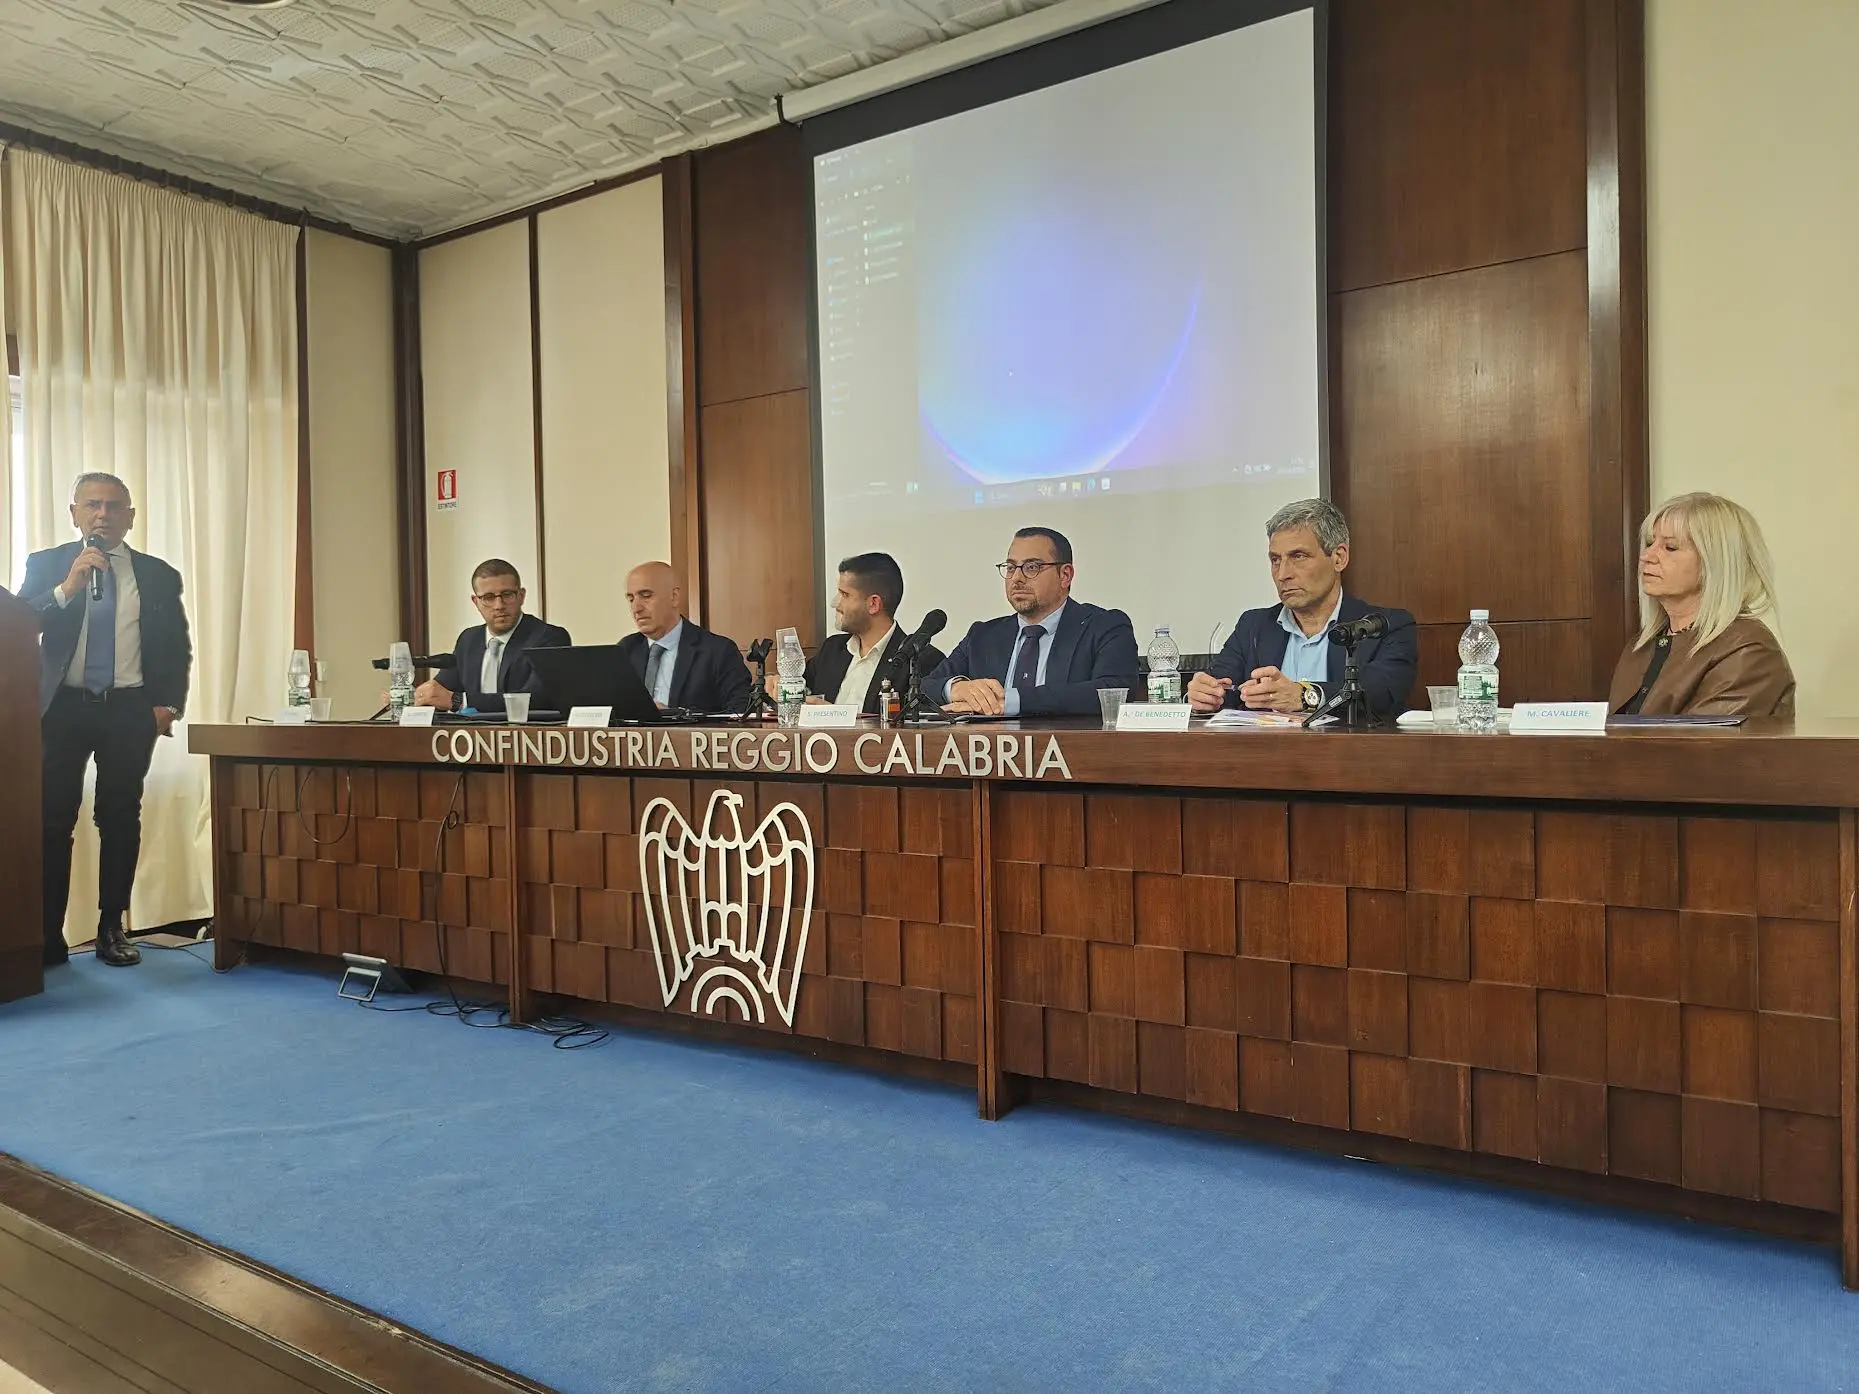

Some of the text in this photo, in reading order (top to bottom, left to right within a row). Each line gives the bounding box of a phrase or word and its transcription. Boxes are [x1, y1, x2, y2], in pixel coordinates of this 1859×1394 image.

[1541, 709, 1591, 717] CAVALIERE
[431, 729, 1073, 780] CONFINDUSTRIA REGGIO CALABRIA
